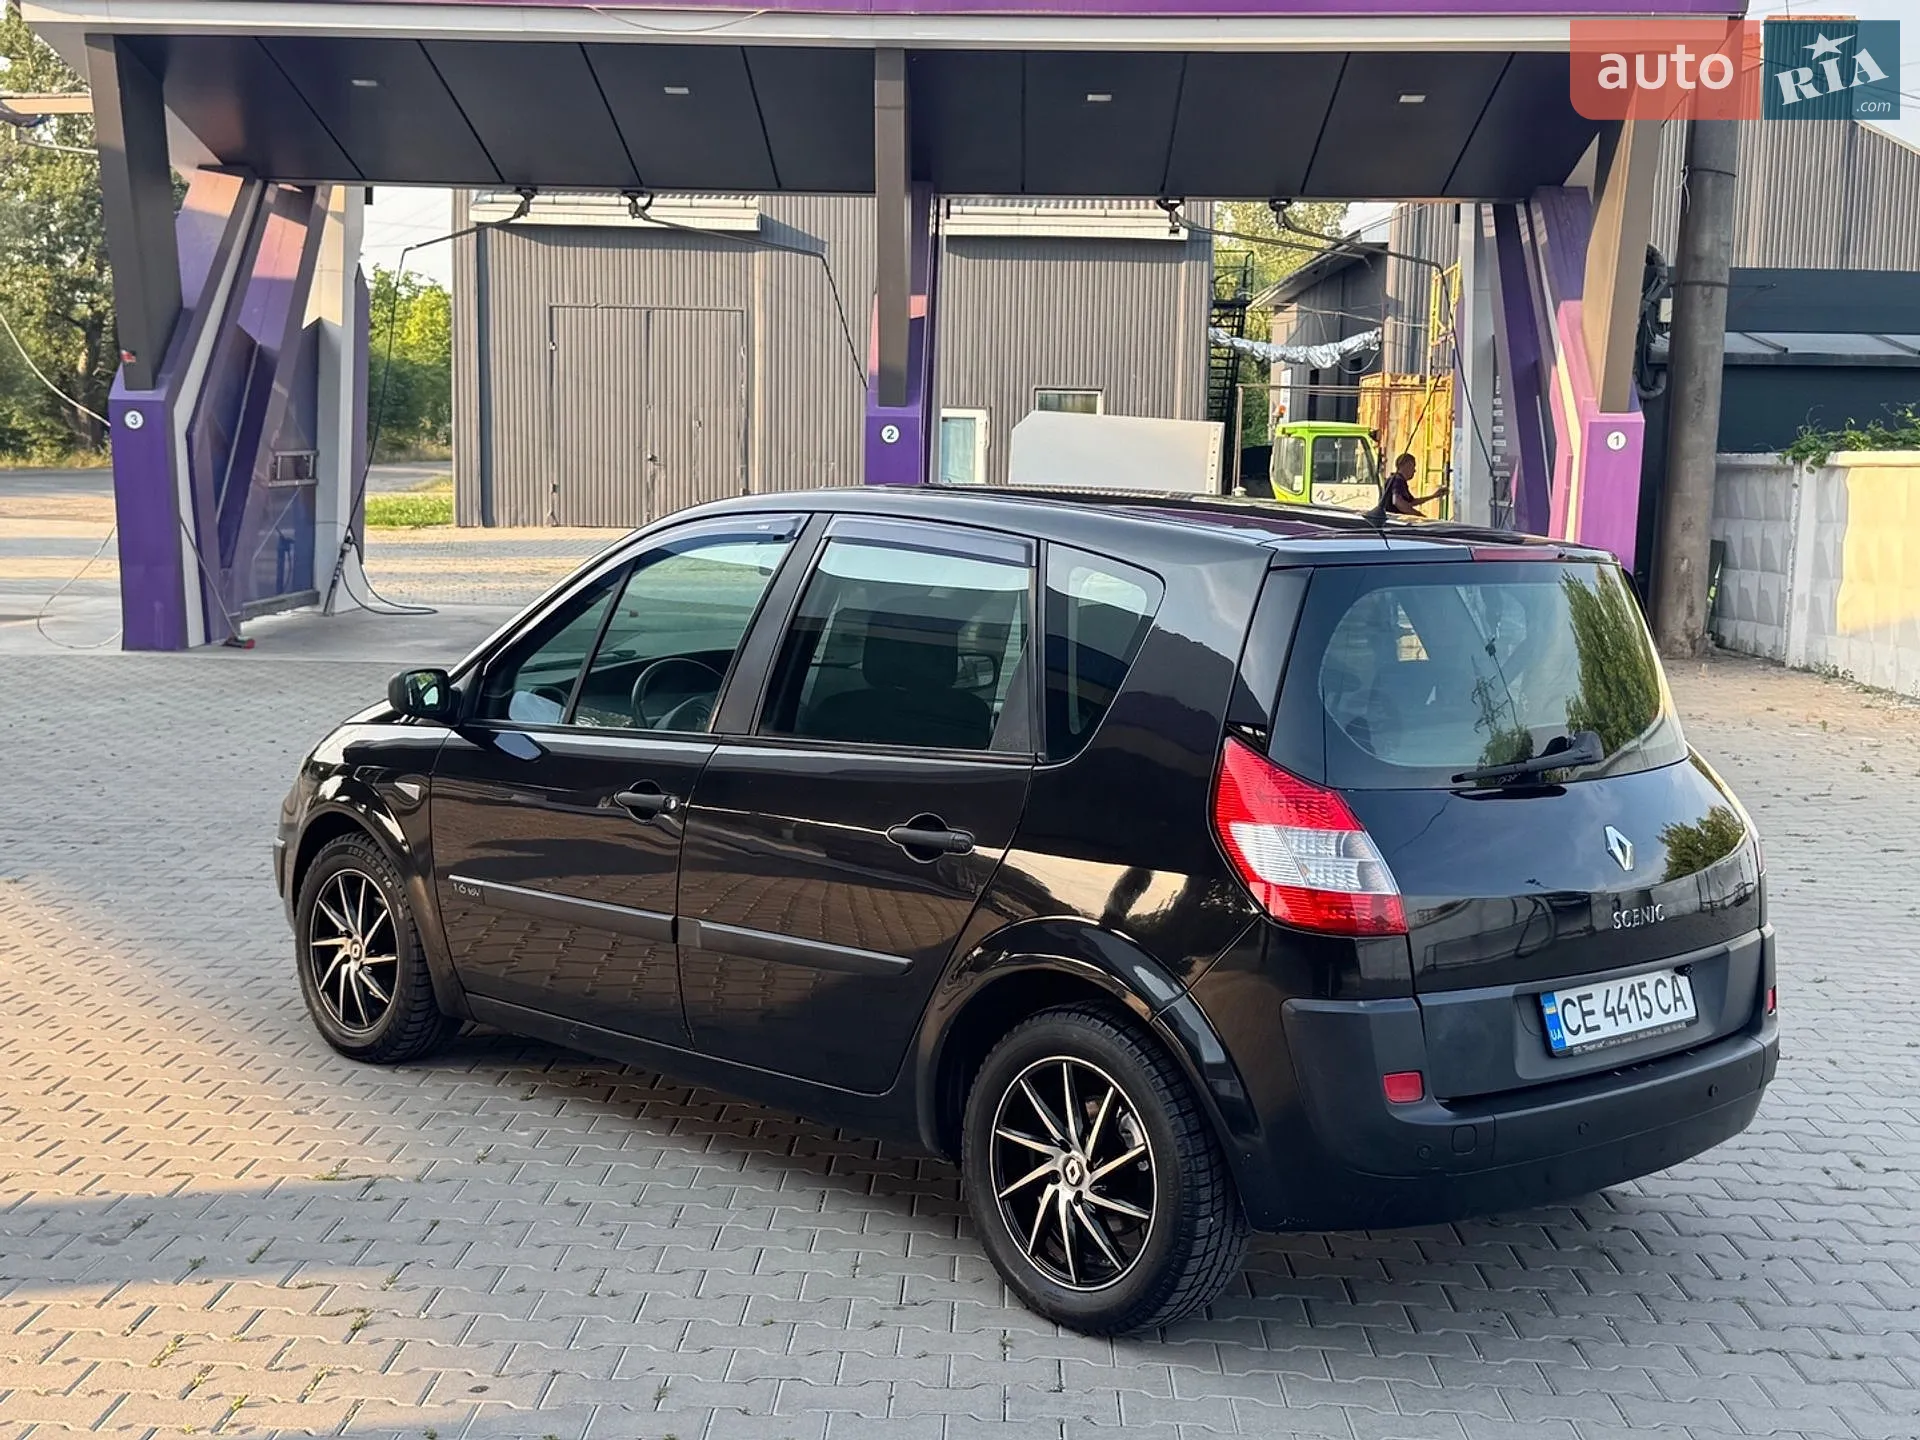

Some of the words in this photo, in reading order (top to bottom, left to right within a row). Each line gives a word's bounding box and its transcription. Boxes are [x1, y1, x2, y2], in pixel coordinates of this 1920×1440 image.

[130, 414, 138, 425] 3
[886, 429, 895, 440] 2
[1613, 435, 1620, 446] 1
[1613, 903, 1665, 929] SCENIC
[1561, 992, 1601, 1036] CE
[1603, 981, 1654, 1027] 4415
[1655, 975, 1688, 1015] CA
[1550, 1029, 1564, 1041] UA
